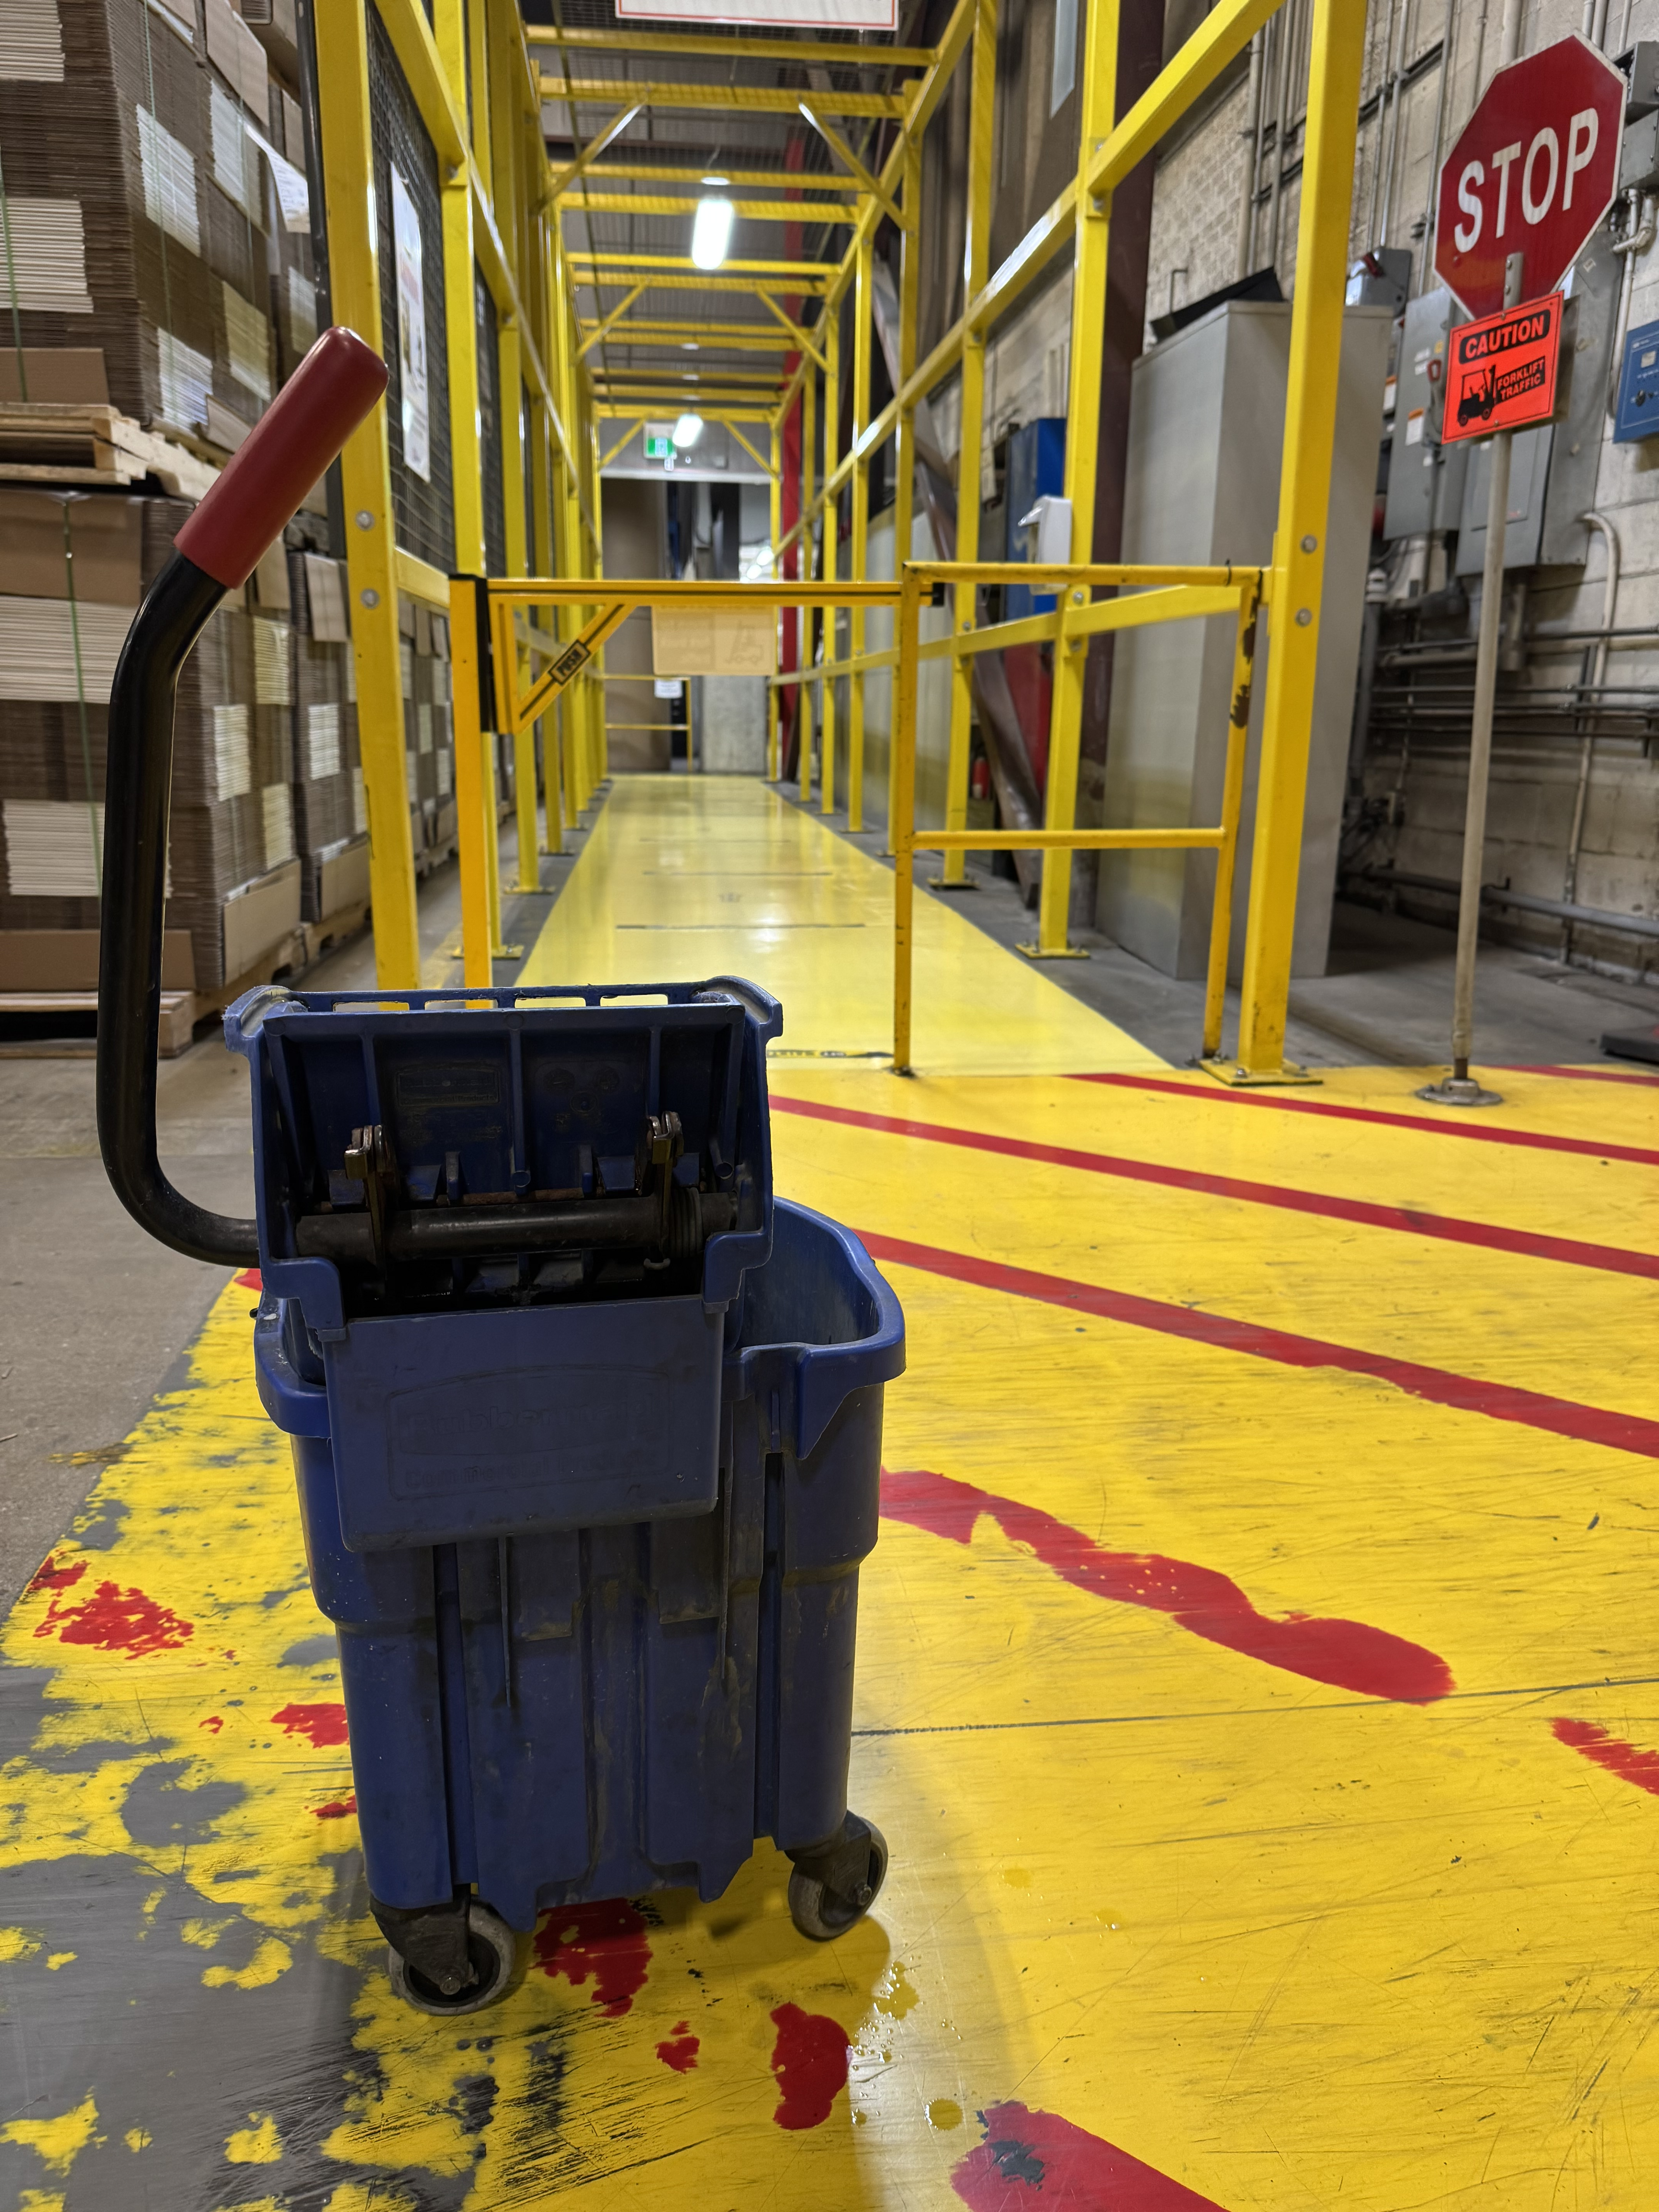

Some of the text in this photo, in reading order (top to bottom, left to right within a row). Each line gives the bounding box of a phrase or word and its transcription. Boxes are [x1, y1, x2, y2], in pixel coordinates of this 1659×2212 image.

[1455, 108, 1599, 252] STOP
[1465, 314, 1544, 359] CAUTION
[1497, 359, 1544, 390] FORKLIFT
[1500, 373, 1541, 400] TRAFFIC
[405, 1393, 653, 1434] Rubbermaid
[406, 1455, 547, 1489] Commercial
